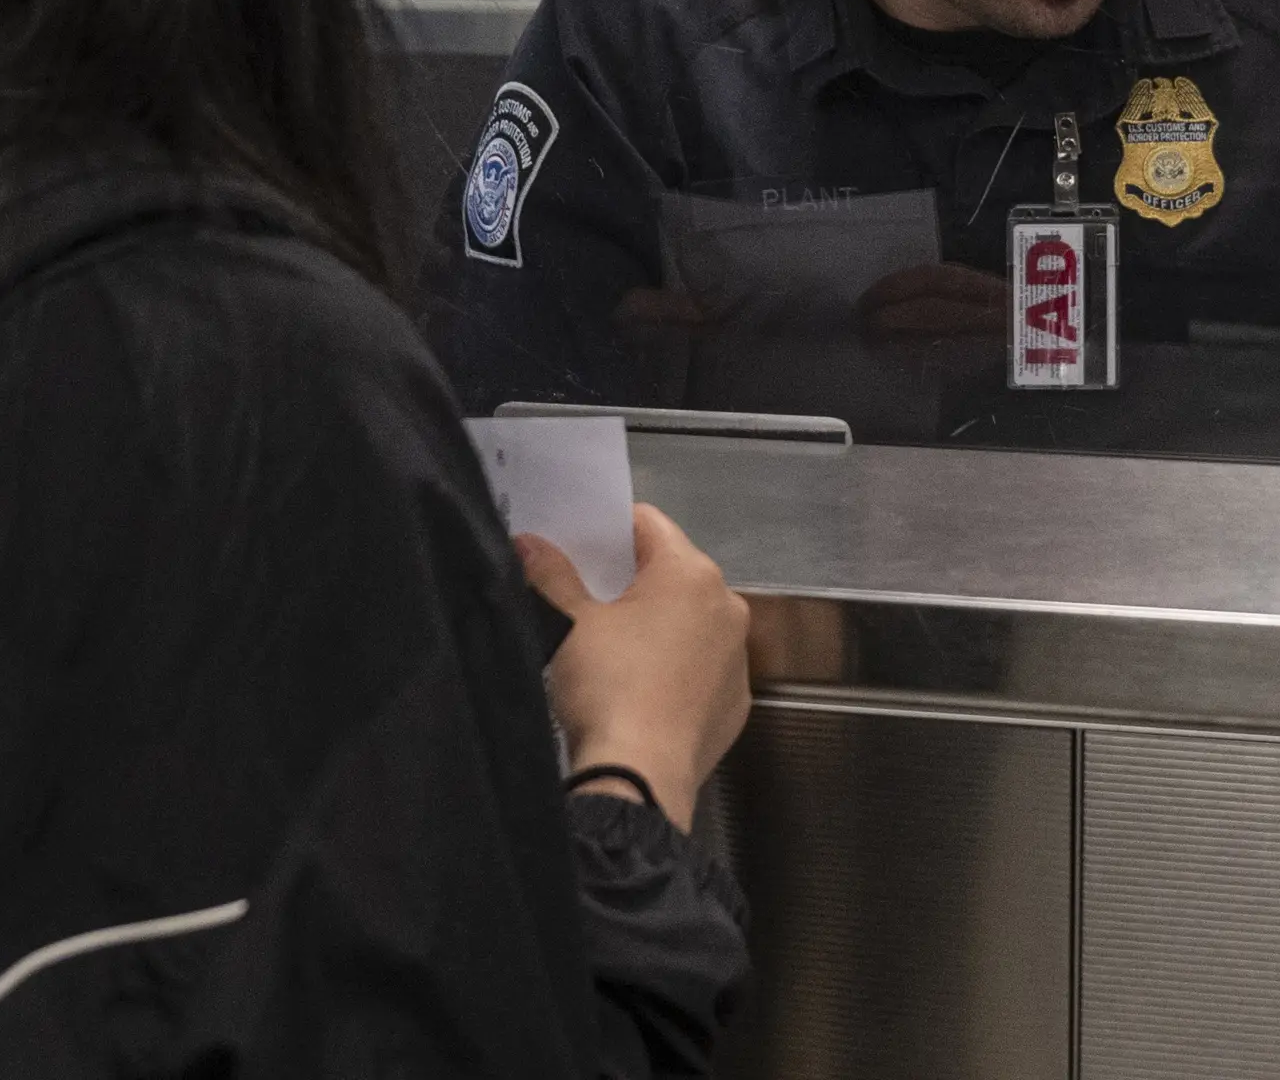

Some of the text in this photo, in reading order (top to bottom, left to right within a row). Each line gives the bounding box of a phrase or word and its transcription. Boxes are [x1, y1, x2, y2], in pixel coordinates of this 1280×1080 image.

[498, 99, 532, 124] CUSTOMS
[526, 121, 539, 138] AND
[1128, 123, 1207, 133] U.S. CUSTOMS AND
[500, 119, 532, 170] PROTECTION
[1128, 132, 1207, 143] BORDER PROTECTION
[762, 186, 860, 212] PLANT
[1142, 190, 1201, 211] OFFICER
[1025, 240, 1077, 364] IAD
